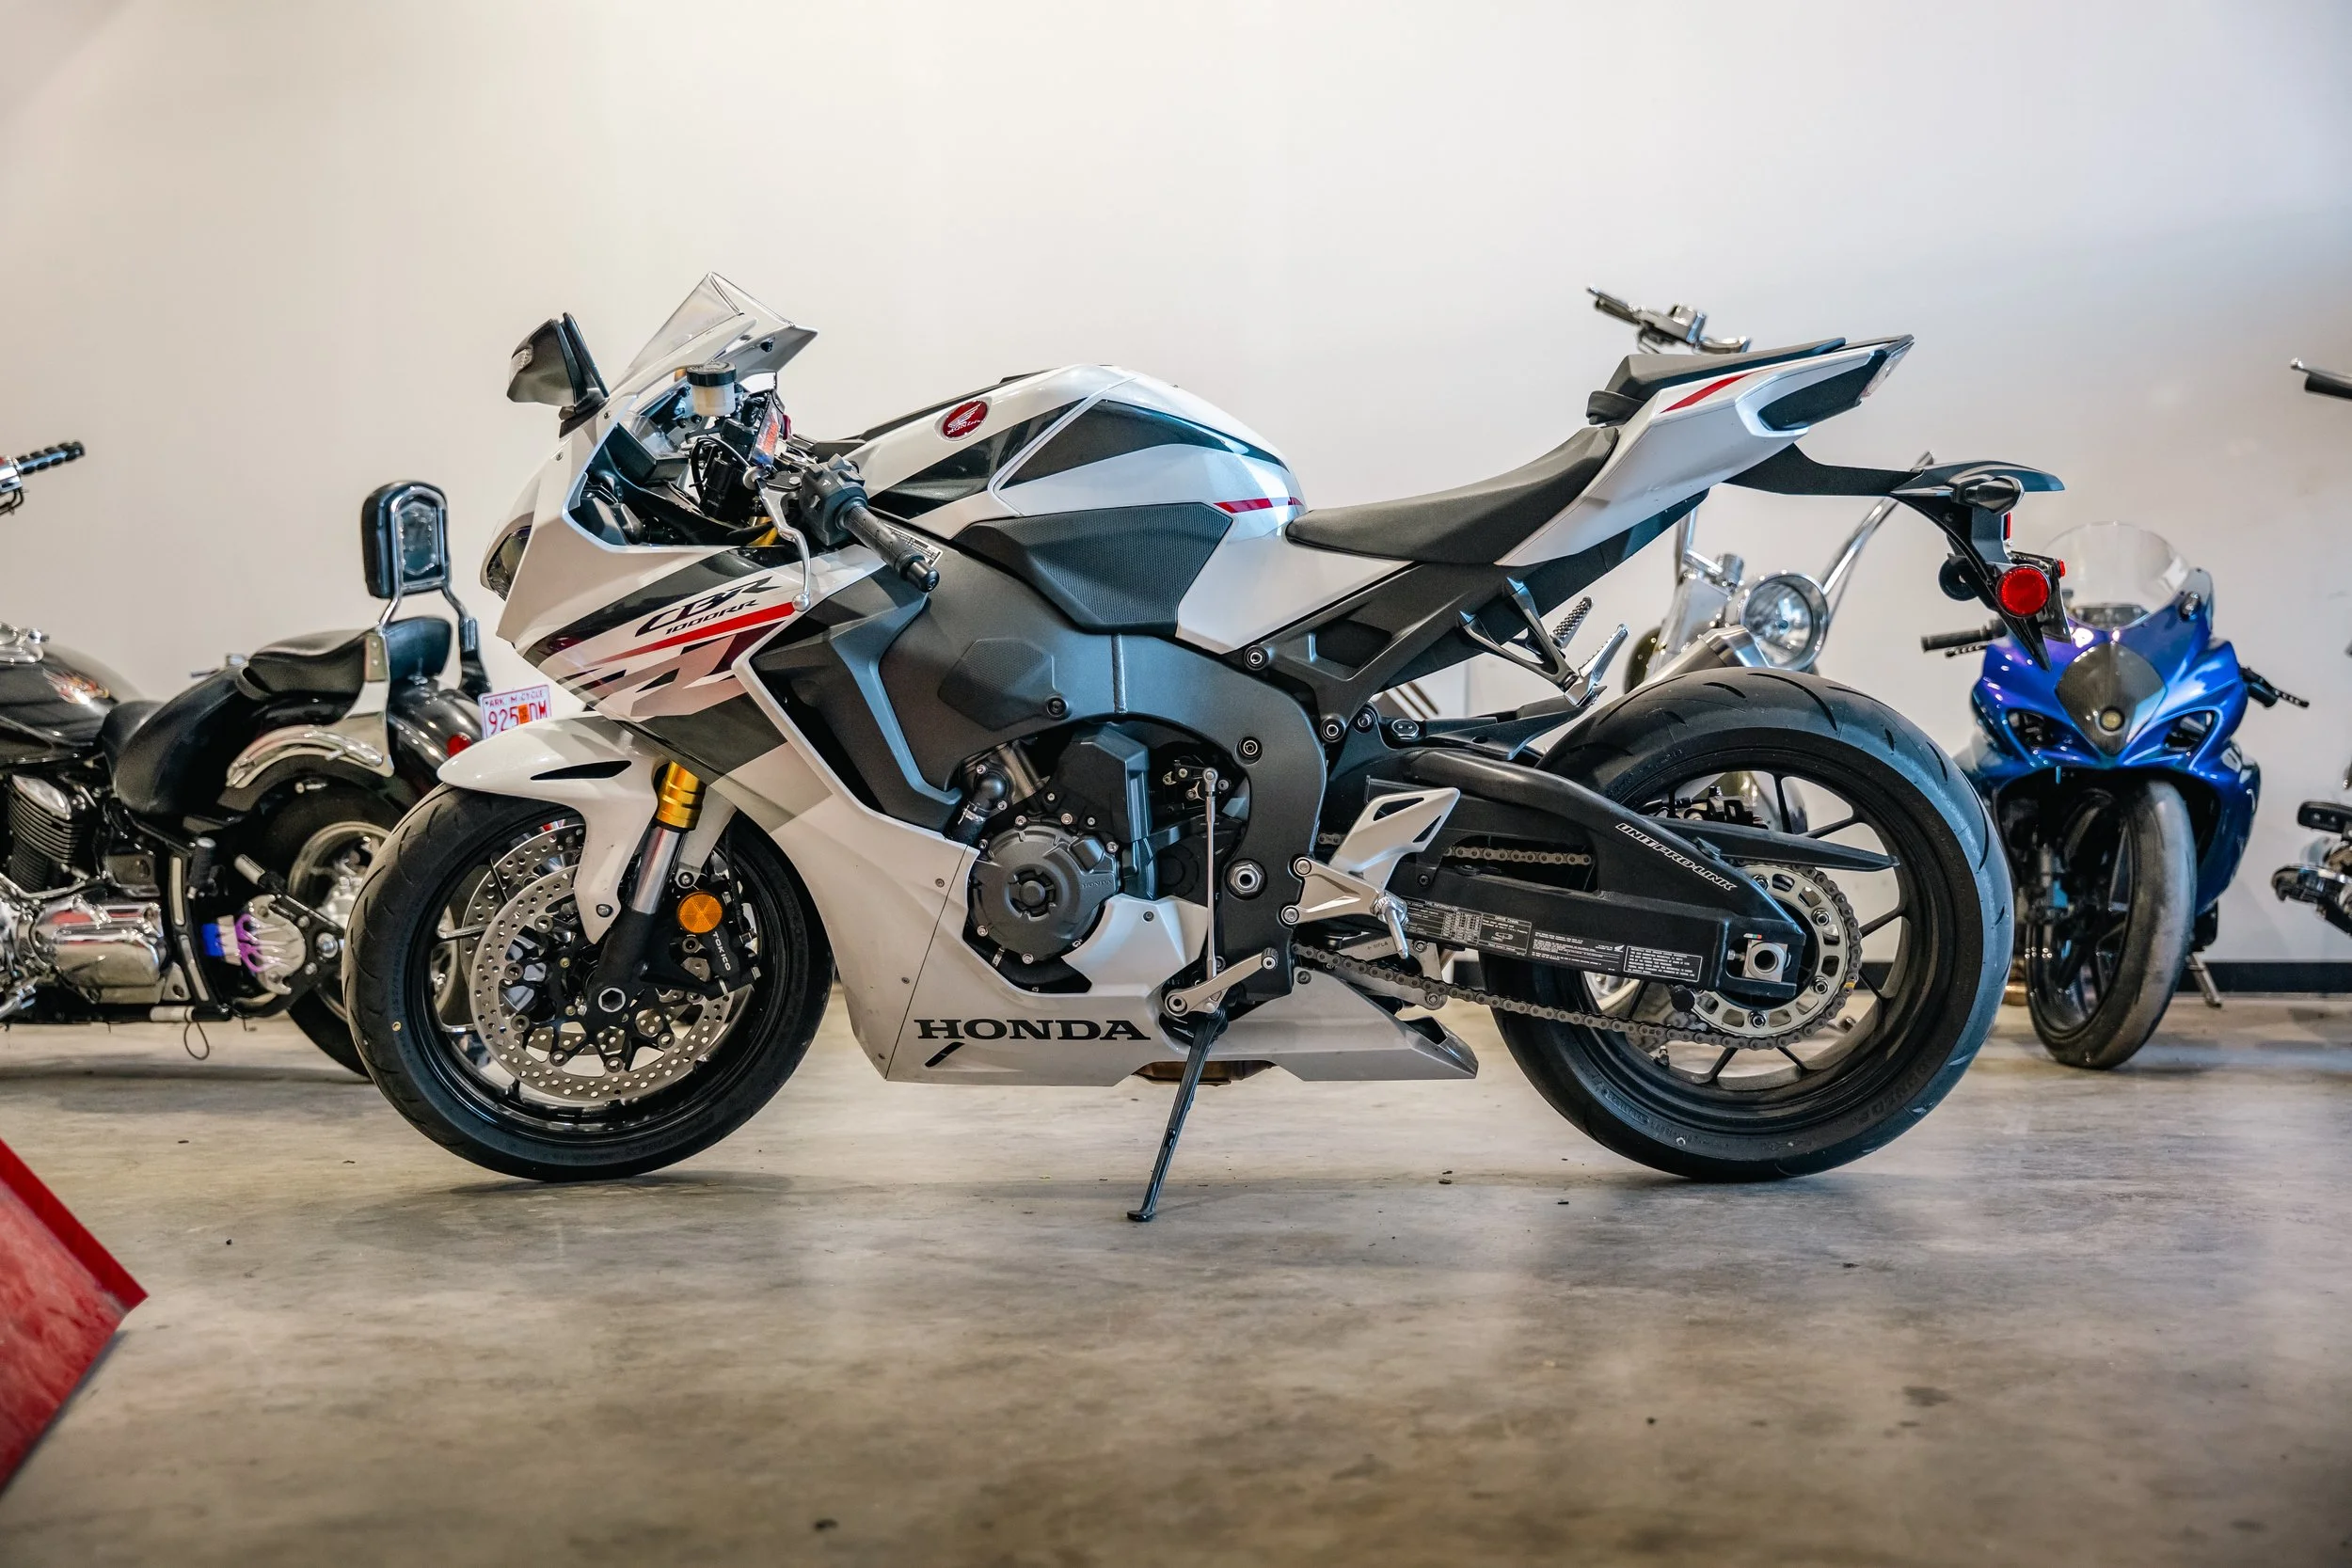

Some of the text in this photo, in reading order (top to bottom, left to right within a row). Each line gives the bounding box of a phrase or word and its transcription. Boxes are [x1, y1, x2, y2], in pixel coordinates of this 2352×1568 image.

[634, 576, 783, 638] CBR
[665, 599, 760, 635] 1000RR
[712, 931, 731, 972] TOKICO
[914, 1019, 1152, 1040] HONDA
